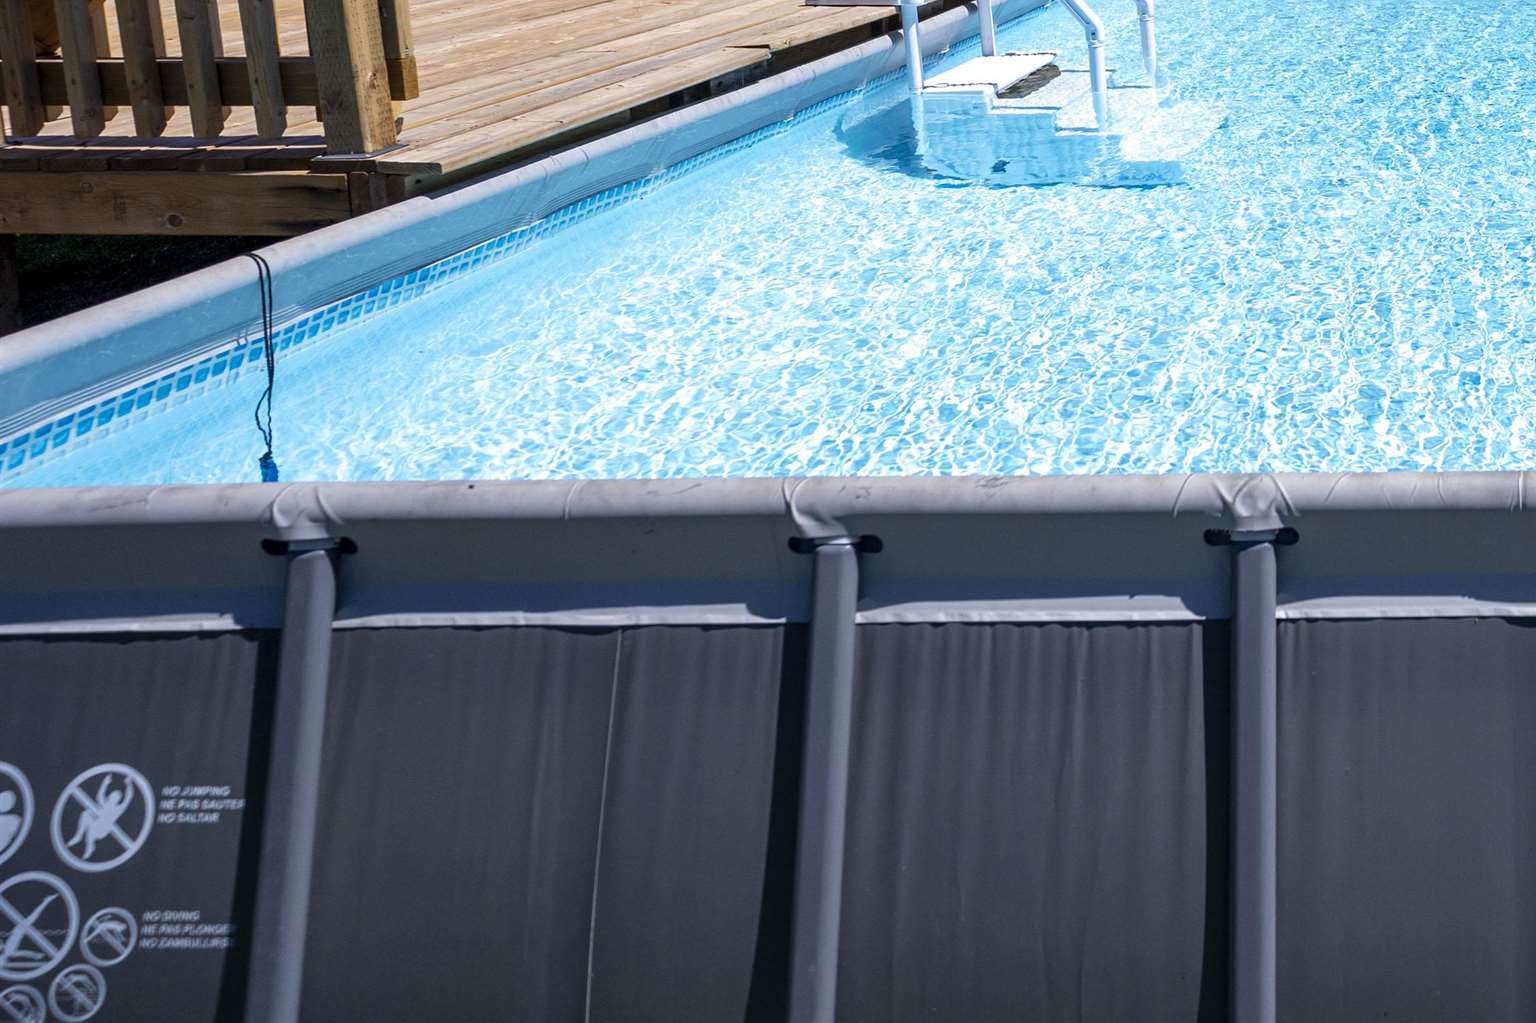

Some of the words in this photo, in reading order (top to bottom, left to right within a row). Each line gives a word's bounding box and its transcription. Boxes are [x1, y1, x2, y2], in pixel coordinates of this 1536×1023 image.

[161, 785, 181, 796] NO
[181, 785, 231, 796] JUMPING
[143, 910, 161, 921] NO
